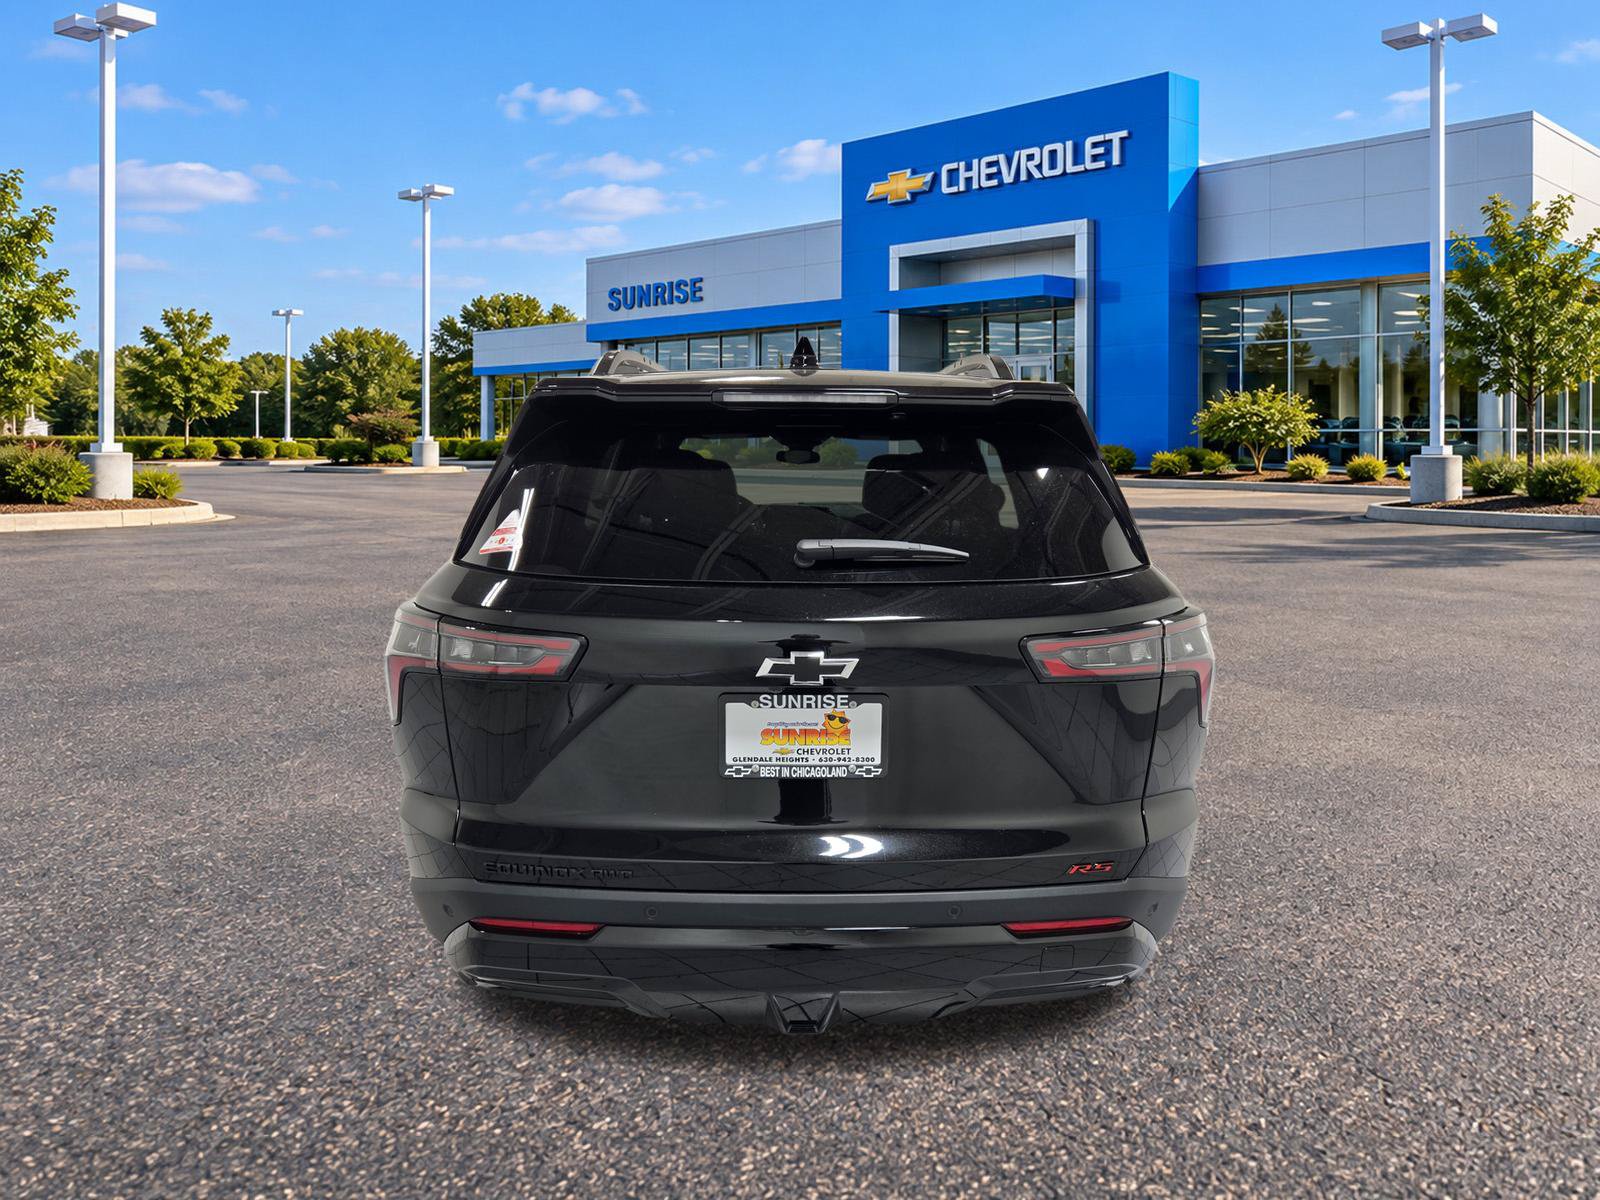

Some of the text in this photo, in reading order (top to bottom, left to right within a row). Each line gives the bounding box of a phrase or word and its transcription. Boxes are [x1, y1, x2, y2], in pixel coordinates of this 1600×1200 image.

[941, 130, 1129, 194] CHEVROLET
[608, 277, 703, 312] SUNRISE
[759, 694, 849, 709] SUNRISE
[760, 728, 851, 746] SUNRISE
[760, 767, 847, 777] BEST IN CHICAGOLAND
[484, 861, 634, 880] EQUINOX AWD
[1067, 862, 1114, 876] RS
